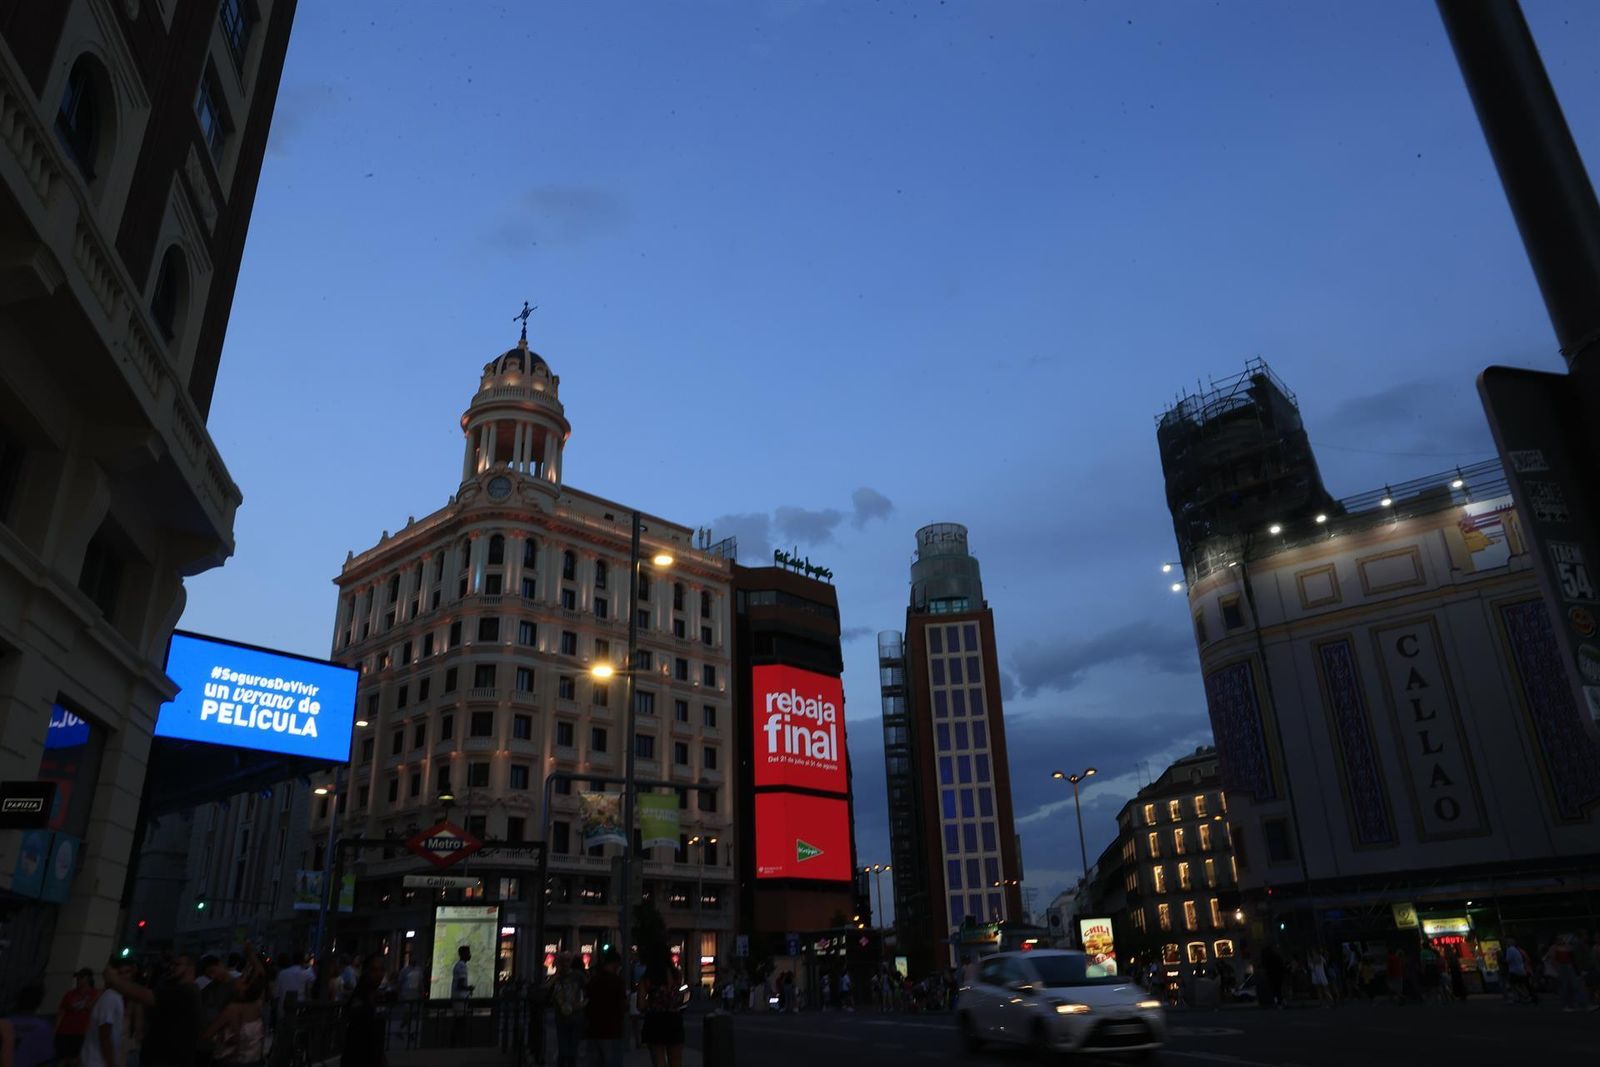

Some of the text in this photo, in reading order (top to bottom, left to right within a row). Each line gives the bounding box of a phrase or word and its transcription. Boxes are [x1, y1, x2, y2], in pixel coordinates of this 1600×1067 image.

[204, 682, 321, 715] un verano de
[211, 665, 319, 697] #SegurosDeVivir
[200, 698, 318, 738] PELÍCULA
[765, 687, 836, 727] rebaja
[763, 713, 838, 762] final
[1396, 634, 1461, 822] CALLAO
[427, 838, 461, 849] Metro
